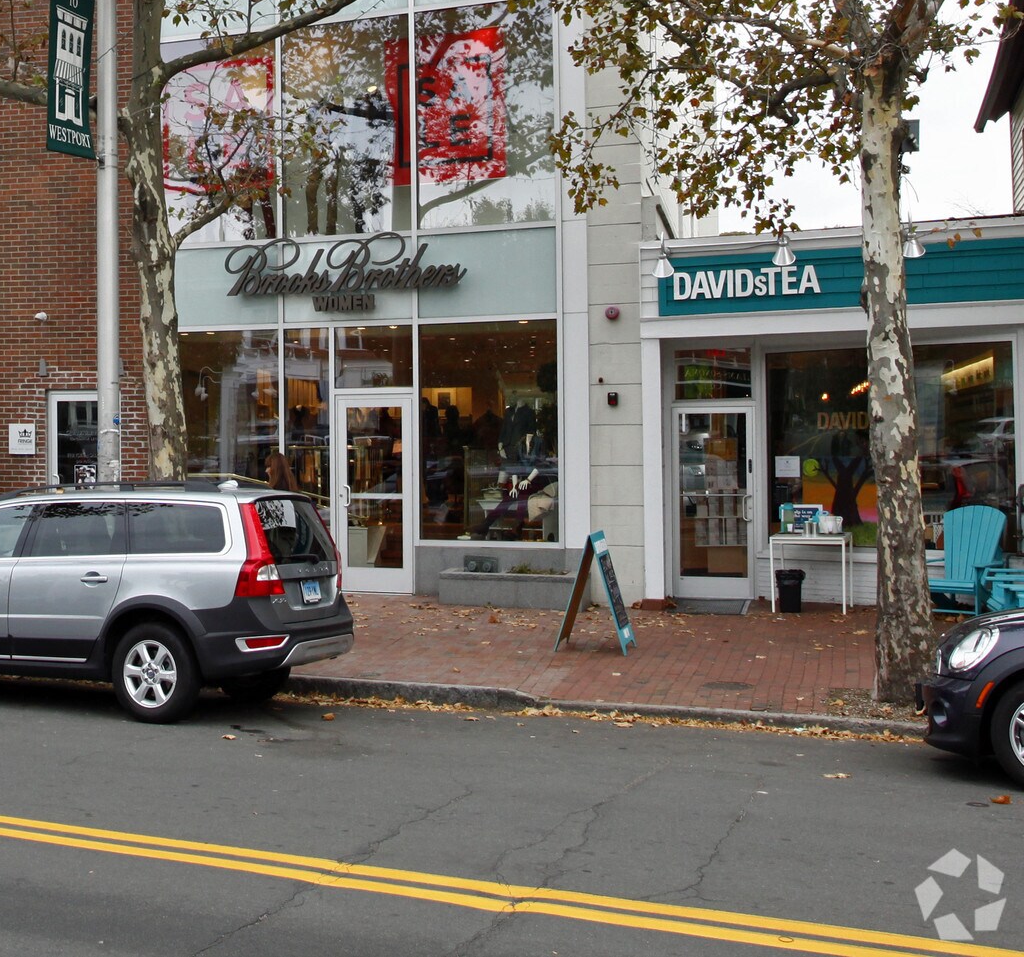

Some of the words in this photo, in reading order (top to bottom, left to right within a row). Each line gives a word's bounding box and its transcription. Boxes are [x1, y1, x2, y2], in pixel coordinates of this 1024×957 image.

[49, 123, 91, 149] WESTPORT
[225, 238, 333, 296] Brooks
[326, 232, 467, 292] Brothers
[673, 265, 821, 301] DAVIDsTEA
[313, 294, 375, 312] WOMEN
